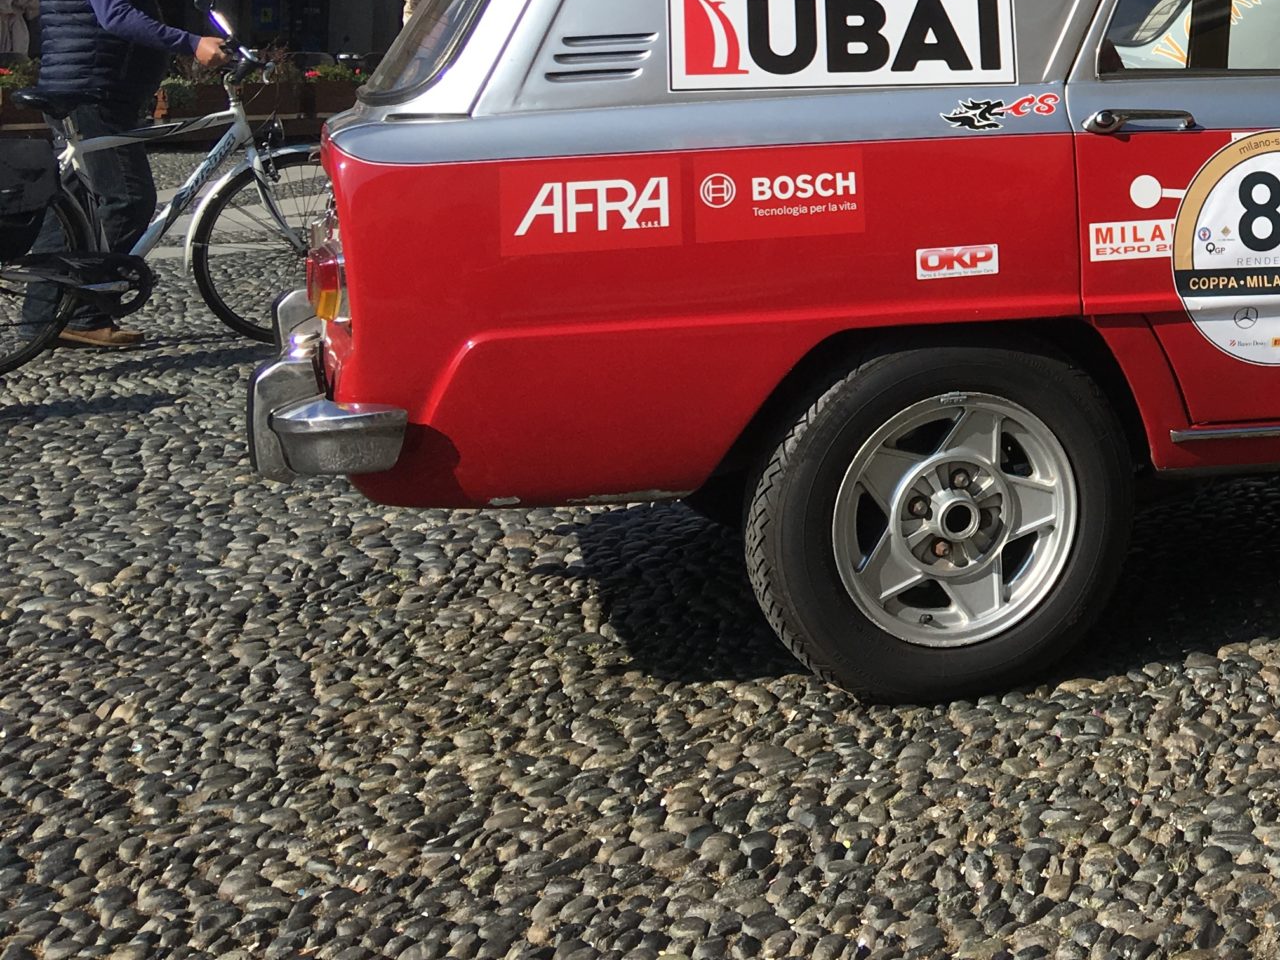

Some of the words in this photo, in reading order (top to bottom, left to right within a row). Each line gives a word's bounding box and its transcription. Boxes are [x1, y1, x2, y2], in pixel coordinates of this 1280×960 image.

[1011, 93, 1060, 117] CS
[752, 171, 856, 201] BOSCH
[514, 176, 670, 236] AFRA
[752, 204, 808, 217] Tecnologia
[810, 204, 826, 215] per
[828, 202, 838, 212] la
[839, 200, 857, 211] vita
[1095, 224, 1175, 245] MILA
[921, 246, 993, 272] OKP
[1096, 246, 1151, 256] EXPO
[1156, 244, 1172, 252] 2
[1189, 276, 1238, 290] COPPA
